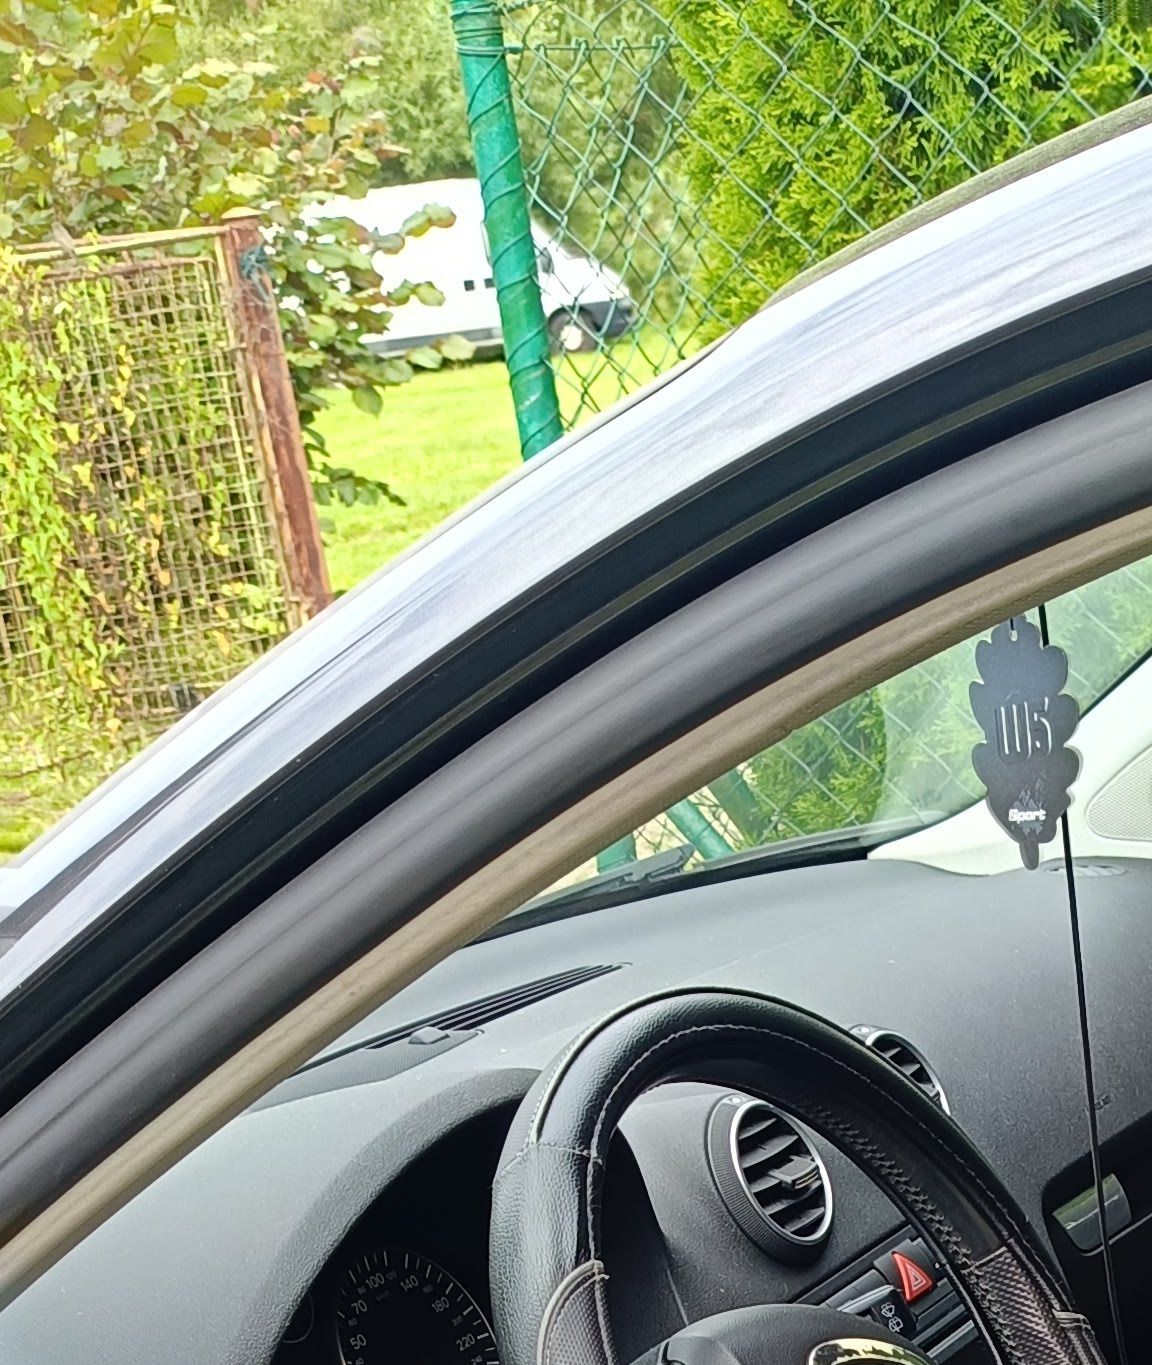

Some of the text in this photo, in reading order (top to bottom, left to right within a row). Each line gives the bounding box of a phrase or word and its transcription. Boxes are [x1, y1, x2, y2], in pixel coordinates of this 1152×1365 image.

[1008, 808, 1047, 825] Sport
[365, 1272, 385, 1290] 100
[400, 1275, 419, 1292] 140
[350, 1299, 368, 1315] 70
[431, 1296, 450, 1313] 180
[349, 1334, 367, 1350] 50
[455, 1333, 476, 1351] 220
